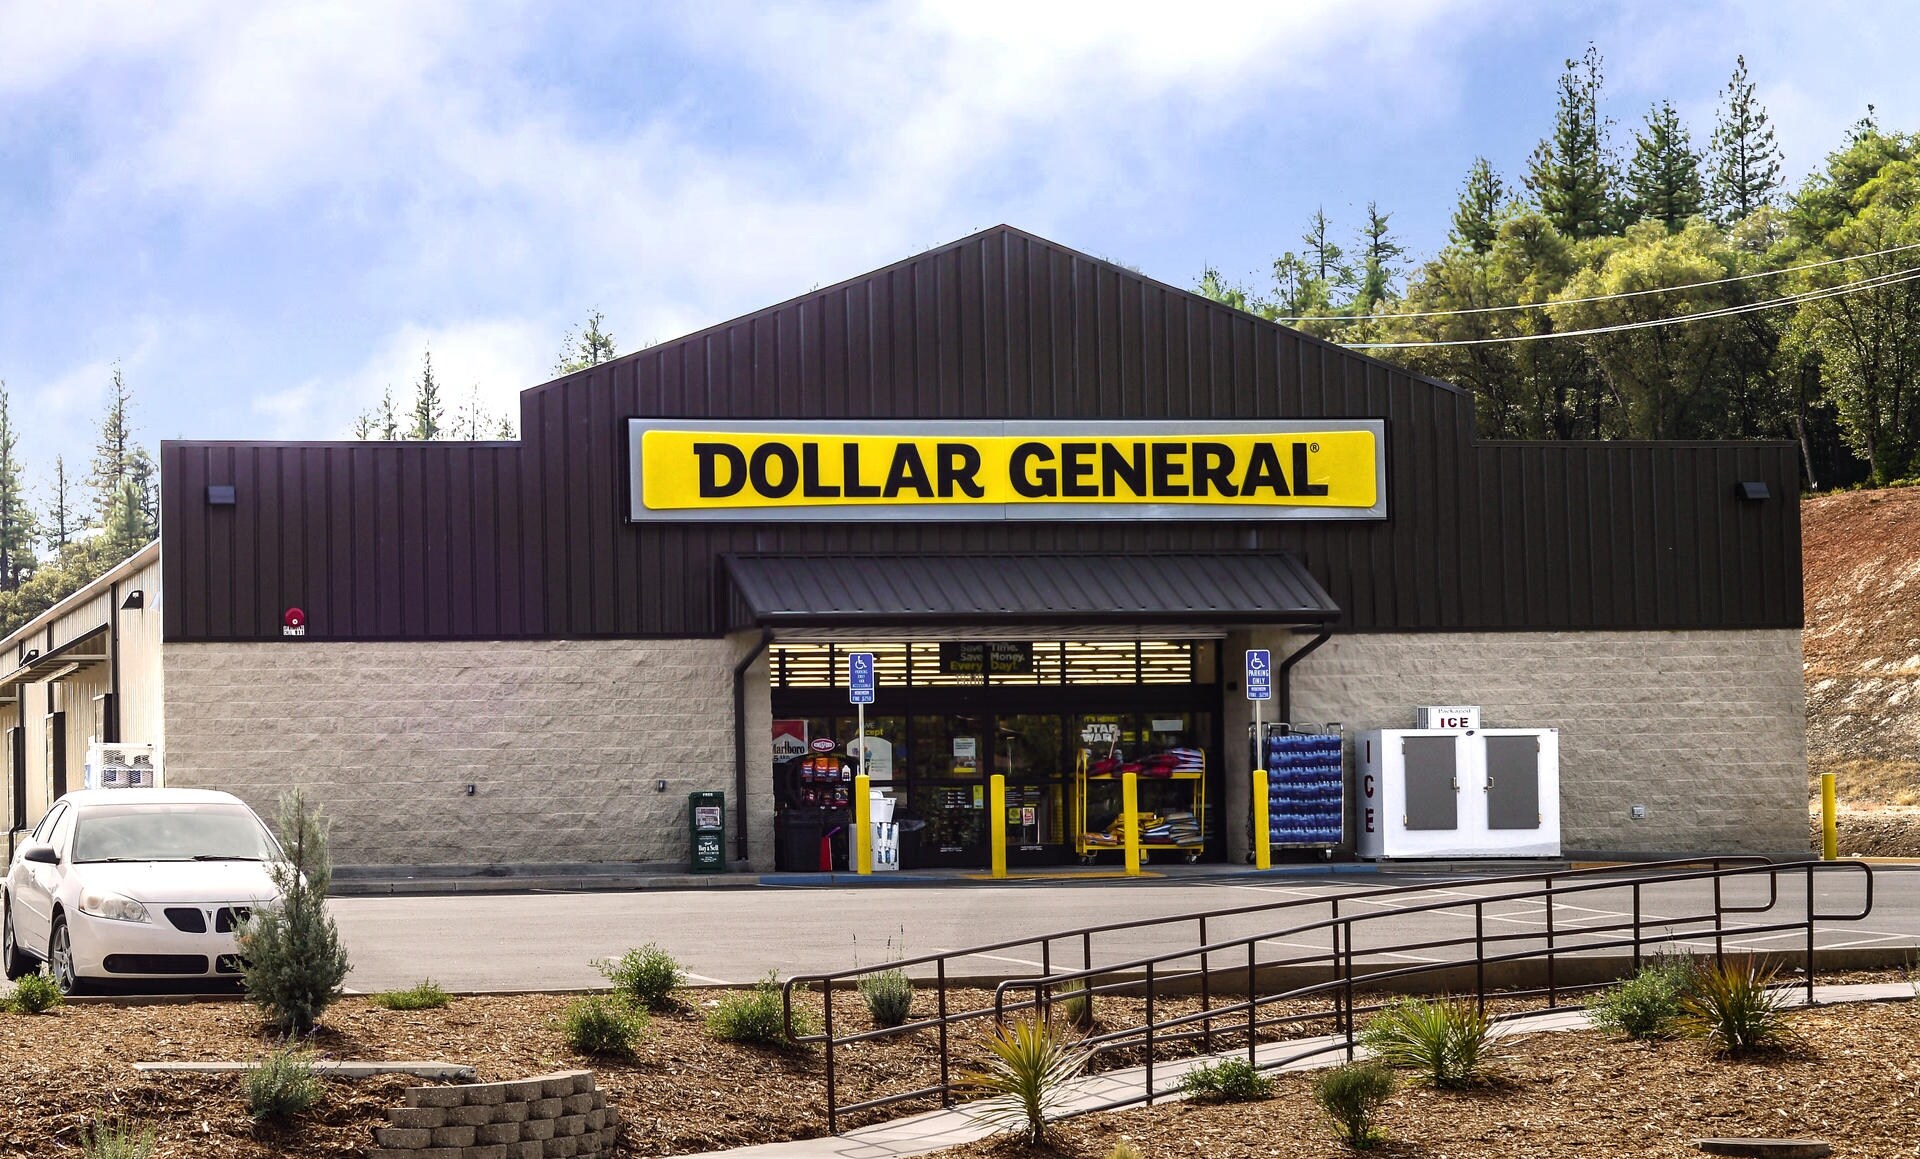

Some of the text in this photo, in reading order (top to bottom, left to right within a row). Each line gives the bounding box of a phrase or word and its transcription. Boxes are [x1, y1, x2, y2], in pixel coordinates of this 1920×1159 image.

[693, 442, 985, 498] DOLLAR
[960, 643, 983, 652] Save
[960, 652, 1025, 663] Save Money.
[950, 661, 983, 671] Every
[1248, 669, 1269, 677] PARKING
[1252, 677, 1265, 685] ONLY
[1440, 717, 1469, 728] ICE
[1081, 723, 1120, 734] STAR
[1363, 740, 1375, 833] ICE
